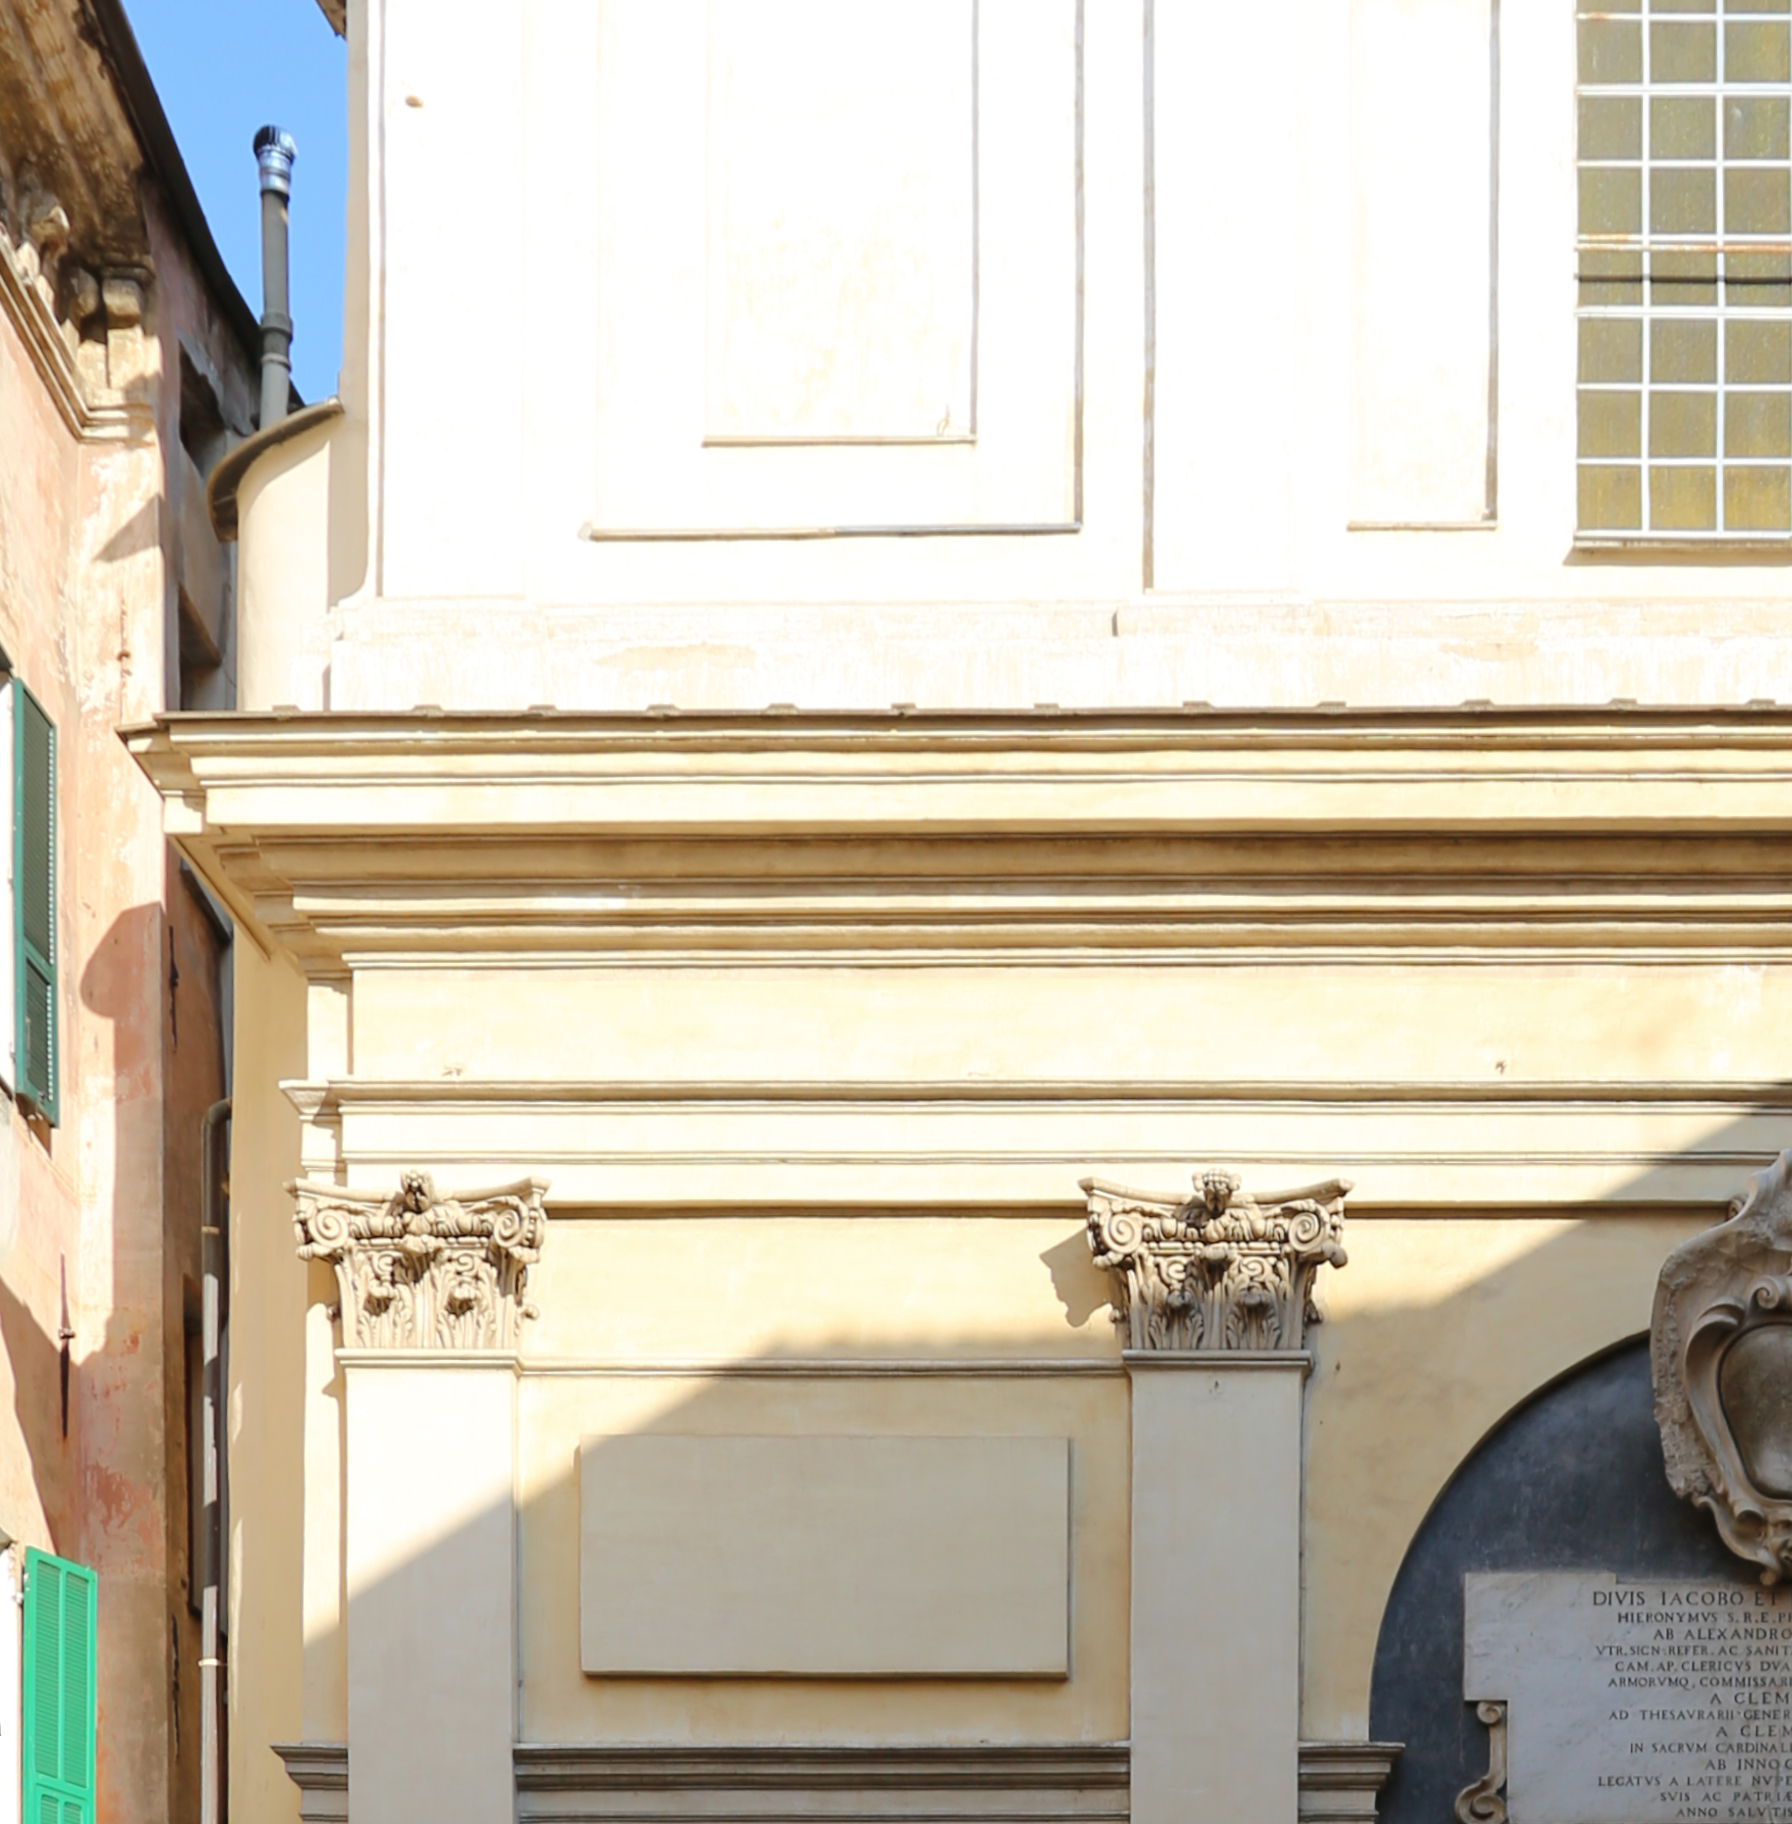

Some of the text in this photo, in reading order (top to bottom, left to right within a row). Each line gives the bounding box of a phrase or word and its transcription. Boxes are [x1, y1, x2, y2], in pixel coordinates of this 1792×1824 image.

[1593, 1591, 1645, 1605] DIVIS
[1661, 1591, 1743, 1605] IACOBO
[1755, 1592, 1778, 1605] ET
[1618, 1612, 1717, 1623] HIERONYMVS
[1654, 1629, 1674, 1640] AB
[1685, 1628, 1792, 1640] ALEXANDRO
[1719, 1645, 1738, 1656] AC
[1681, 1661, 1751, 1672] CLERICVS
[1710, 1693, 1722, 1705] A
[1609, 1710, 1628, 1720] AD
[1716, 1726, 1728, 1737] A
[1630, 1743, 1643, 1753] IN
[1652, 1743, 1707, 1753] SACRVM
[1706, 1759, 1726, 1770] AB
[1669, 1776, 1678, 1786] A
[1687, 1776, 1742, 1786] LATERE
[1660, 1792, 1690, 1801] SVIS
[1702, 1792, 1721, 1801] AC
[1676, 1807, 1717, 1817] ANNO
[1729, 1807, 1792, 1817] SALVTIS
